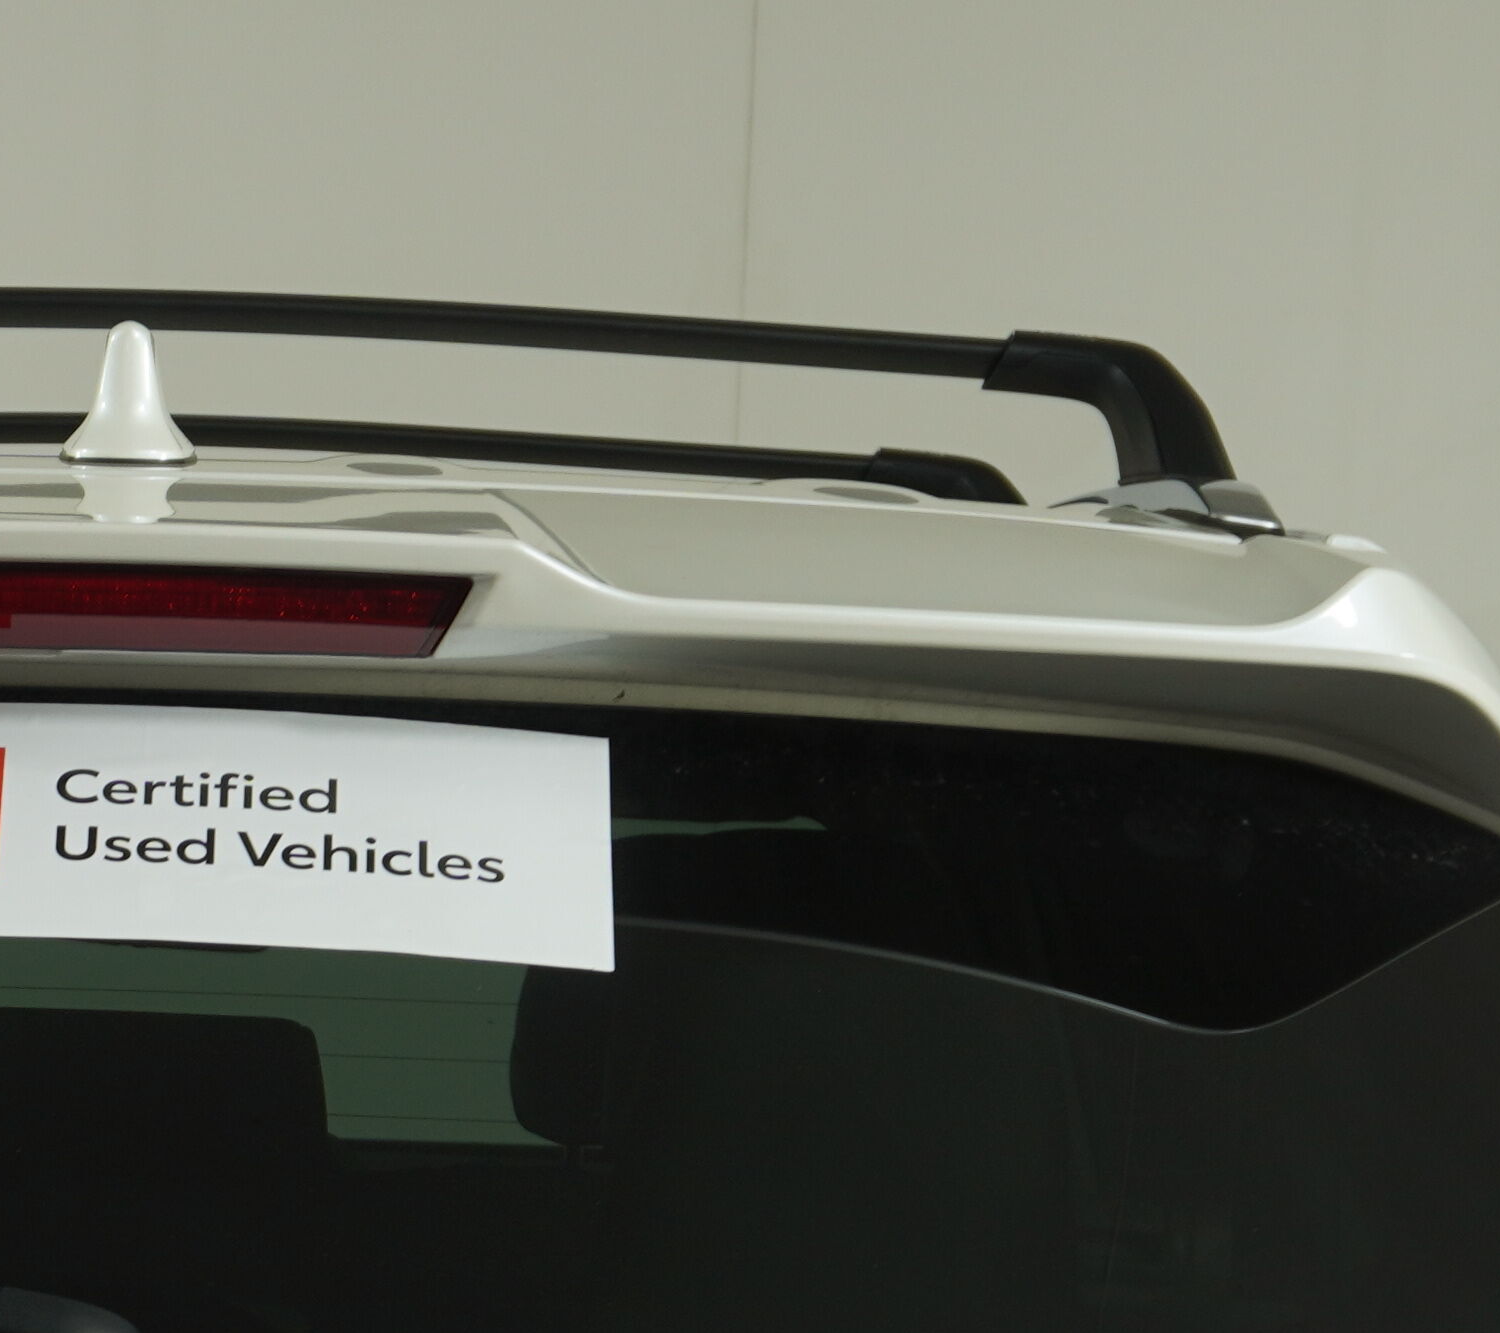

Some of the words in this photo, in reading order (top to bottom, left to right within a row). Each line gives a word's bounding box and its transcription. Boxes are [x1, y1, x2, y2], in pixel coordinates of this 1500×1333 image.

[53, 767, 339, 815] Certified
[53, 825, 217, 867] Used
[237, 830, 507, 885] Vehicles
